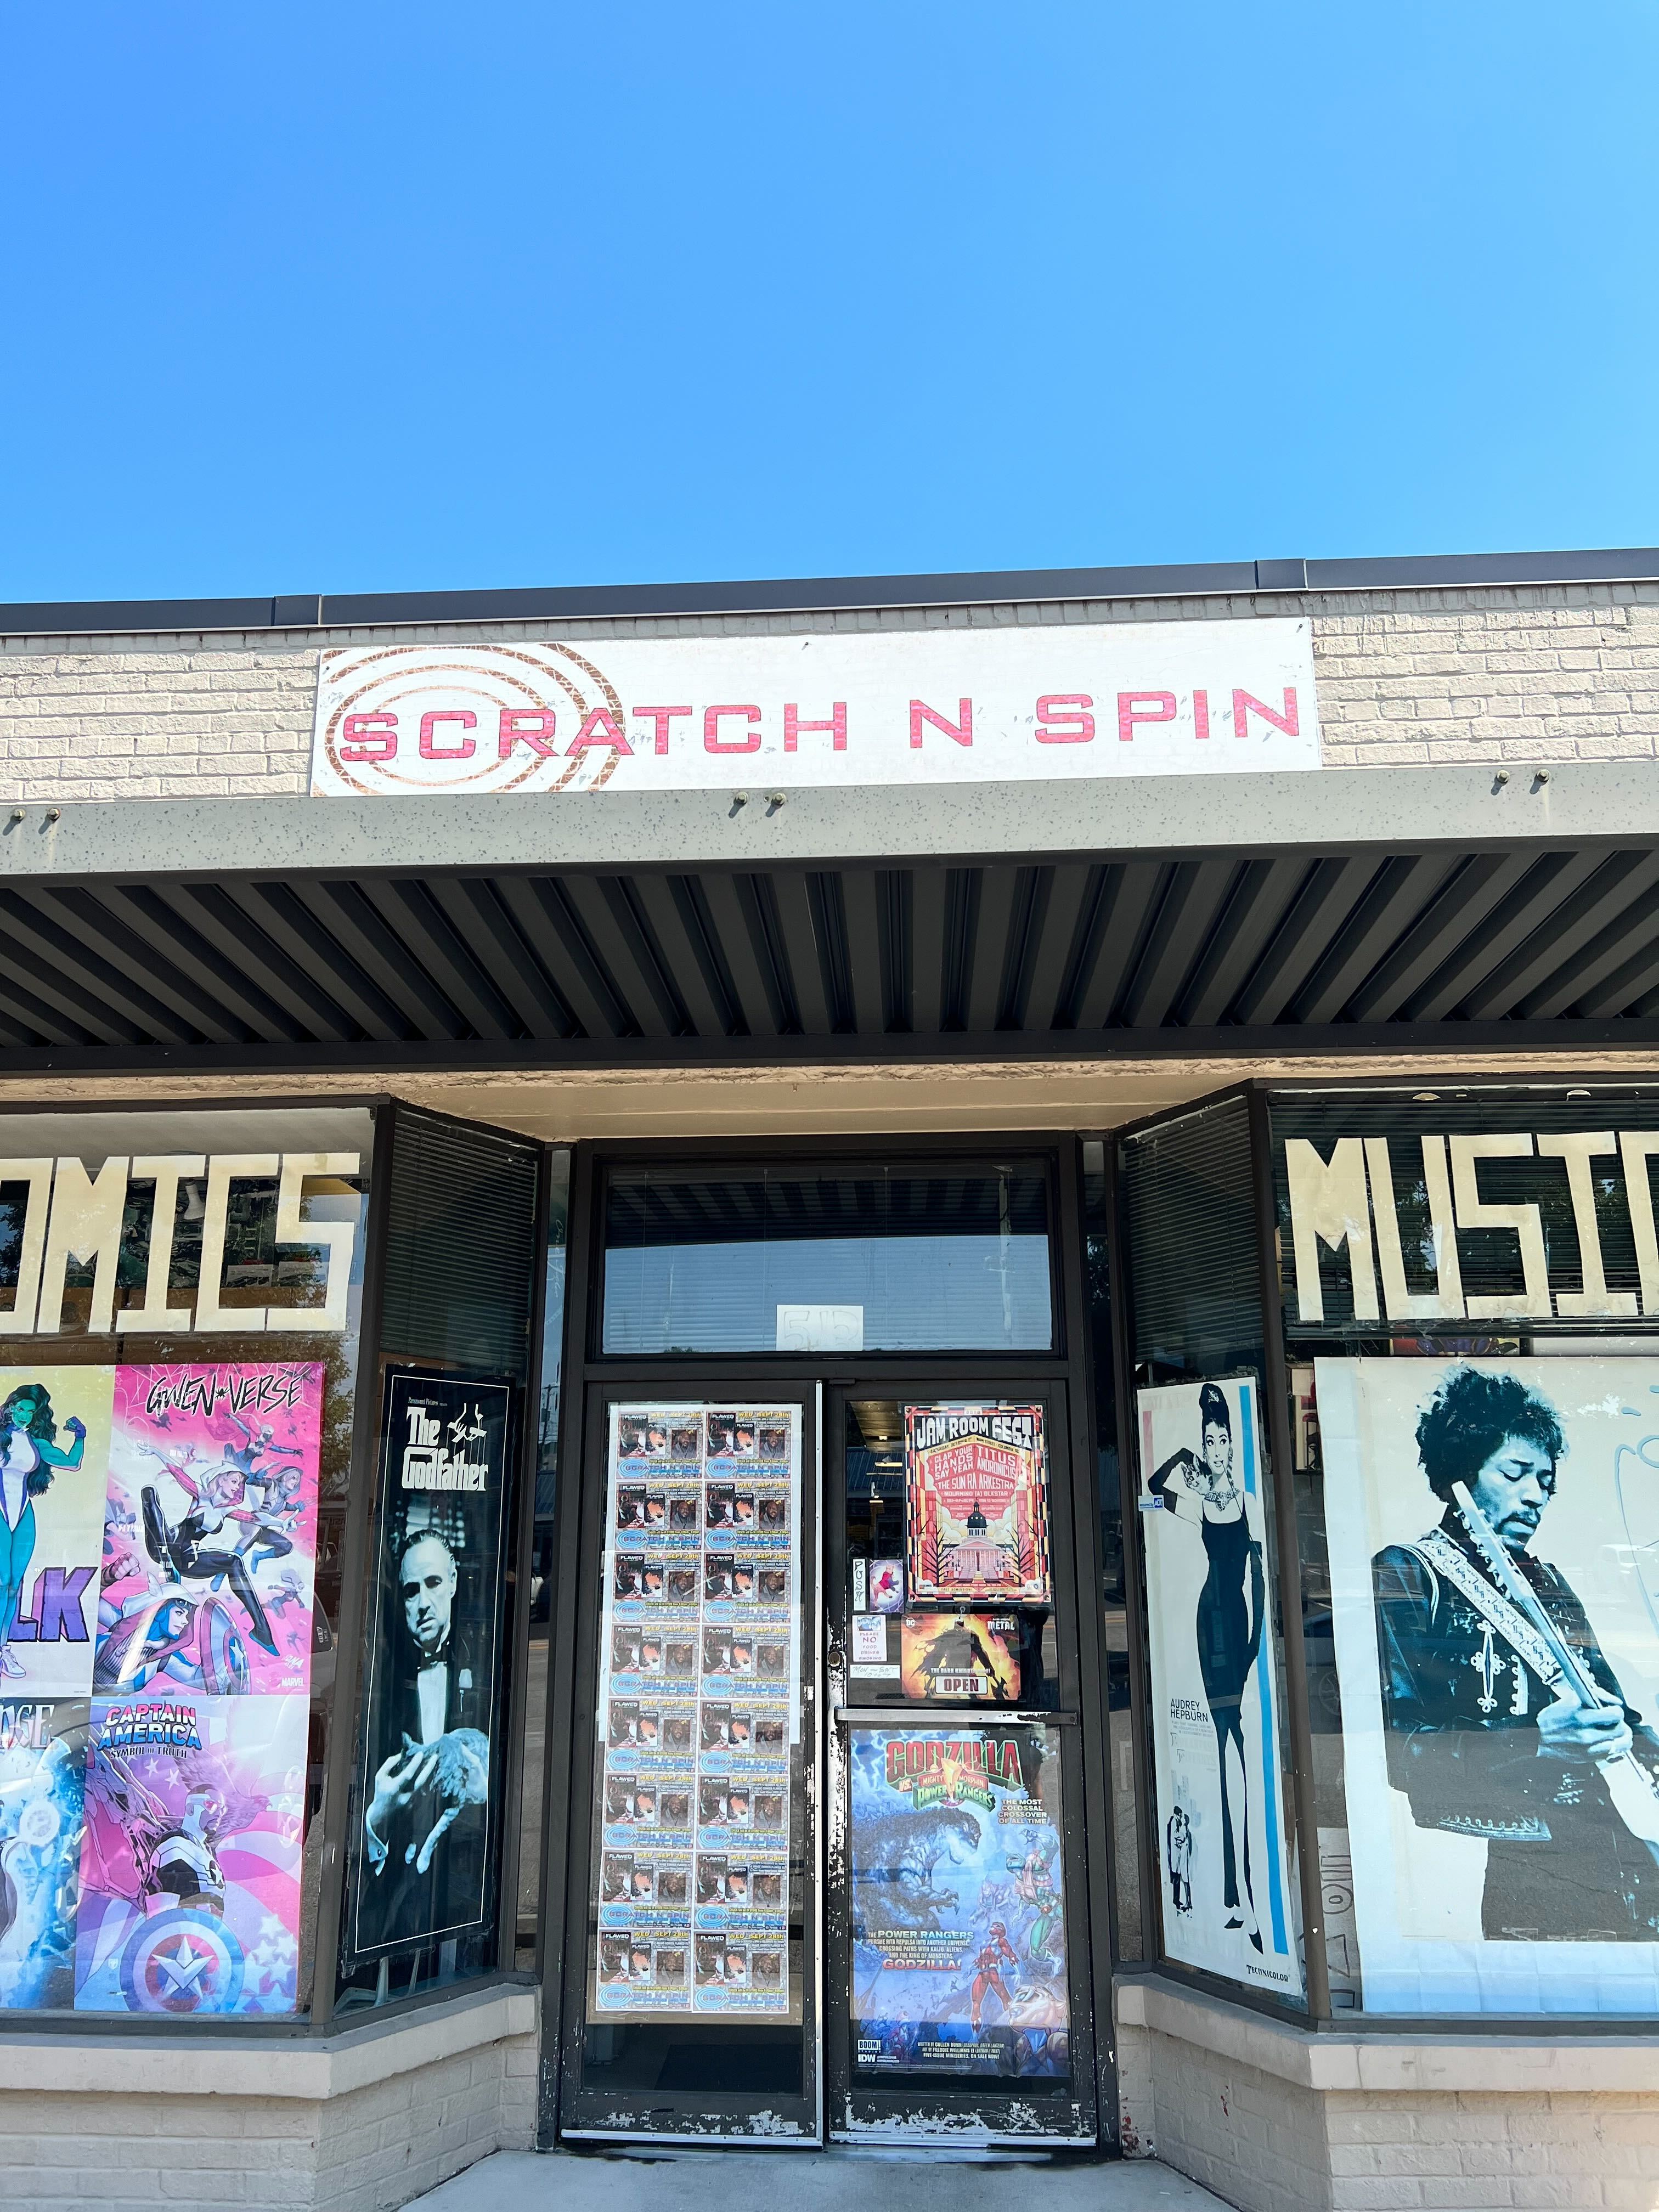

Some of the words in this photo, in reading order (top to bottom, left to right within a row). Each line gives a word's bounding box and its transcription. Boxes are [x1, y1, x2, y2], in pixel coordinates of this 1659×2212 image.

[340, 703, 847, 761] SCRATCH
[909, 697, 973, 748] N
[1035, 686, 1300, 744] SPIN
[406, 1406, 441, 1446] The
[916, 1417, 946, 1449] JAM
[949, 1417, 989, 1440] ROOM
[991, 1417, 1032, 1449] FEST
[934, 1453, 952, 1463] CLAP
[955, 1445, 973, 1457] YOUR
[934, 1454, 973, 1472] HANDS
[975, 1445, 1015, 1466] TITUS
[402, 1446, 489, 1491] Godfather
[935, 1469, 950, 1480] SAY
[953, 1462, 973, 1475] YEAH
[977, 1457, 1015, 1479] ANDRONICUS
[951, 1476, 966, 1489] SUN
[967, 1472, 976, 1489] RA
[979, 1473, 1014, 1489] ARKESTRA
[987, 1621, 1015, 1630] METAL
[281, 1677, 303, 1686] MARVEL
[944, 1679, 979, 1691] OPEN
[1171, 1699, 1200, 1711] AUDREY
[105, 1703, 196, 1726] CAPTAIN
[1171, 1708, 1209, 1723] HEPBURN
[97, 1723, 202, 1751] AMERICA
[110, 1747, 145, 1758] SYMBOL
[156, 1747, 187, 1758] TRUTH
[886, 1741, 1023, 1786] GODZILLA
[923, 1775, 944, 1786] MIGHTY
[959, 1775, 985, 1786] MORPHIN
[917, 1785, 946, 1804] POWER
[955, 1782, 994, 1806] RANGERS
[878, 1931, 917, 1939] POWER
[920, 1931, 974, 1939] RANGERS
[883, 1959, 961, 1971] GODZILLA!
[1246, 1964, 1288, 1982] TECHNICOLOR
[859, 2040, 881, 2050] BOOM!
[858, 2054, 876, 2062] IDW
